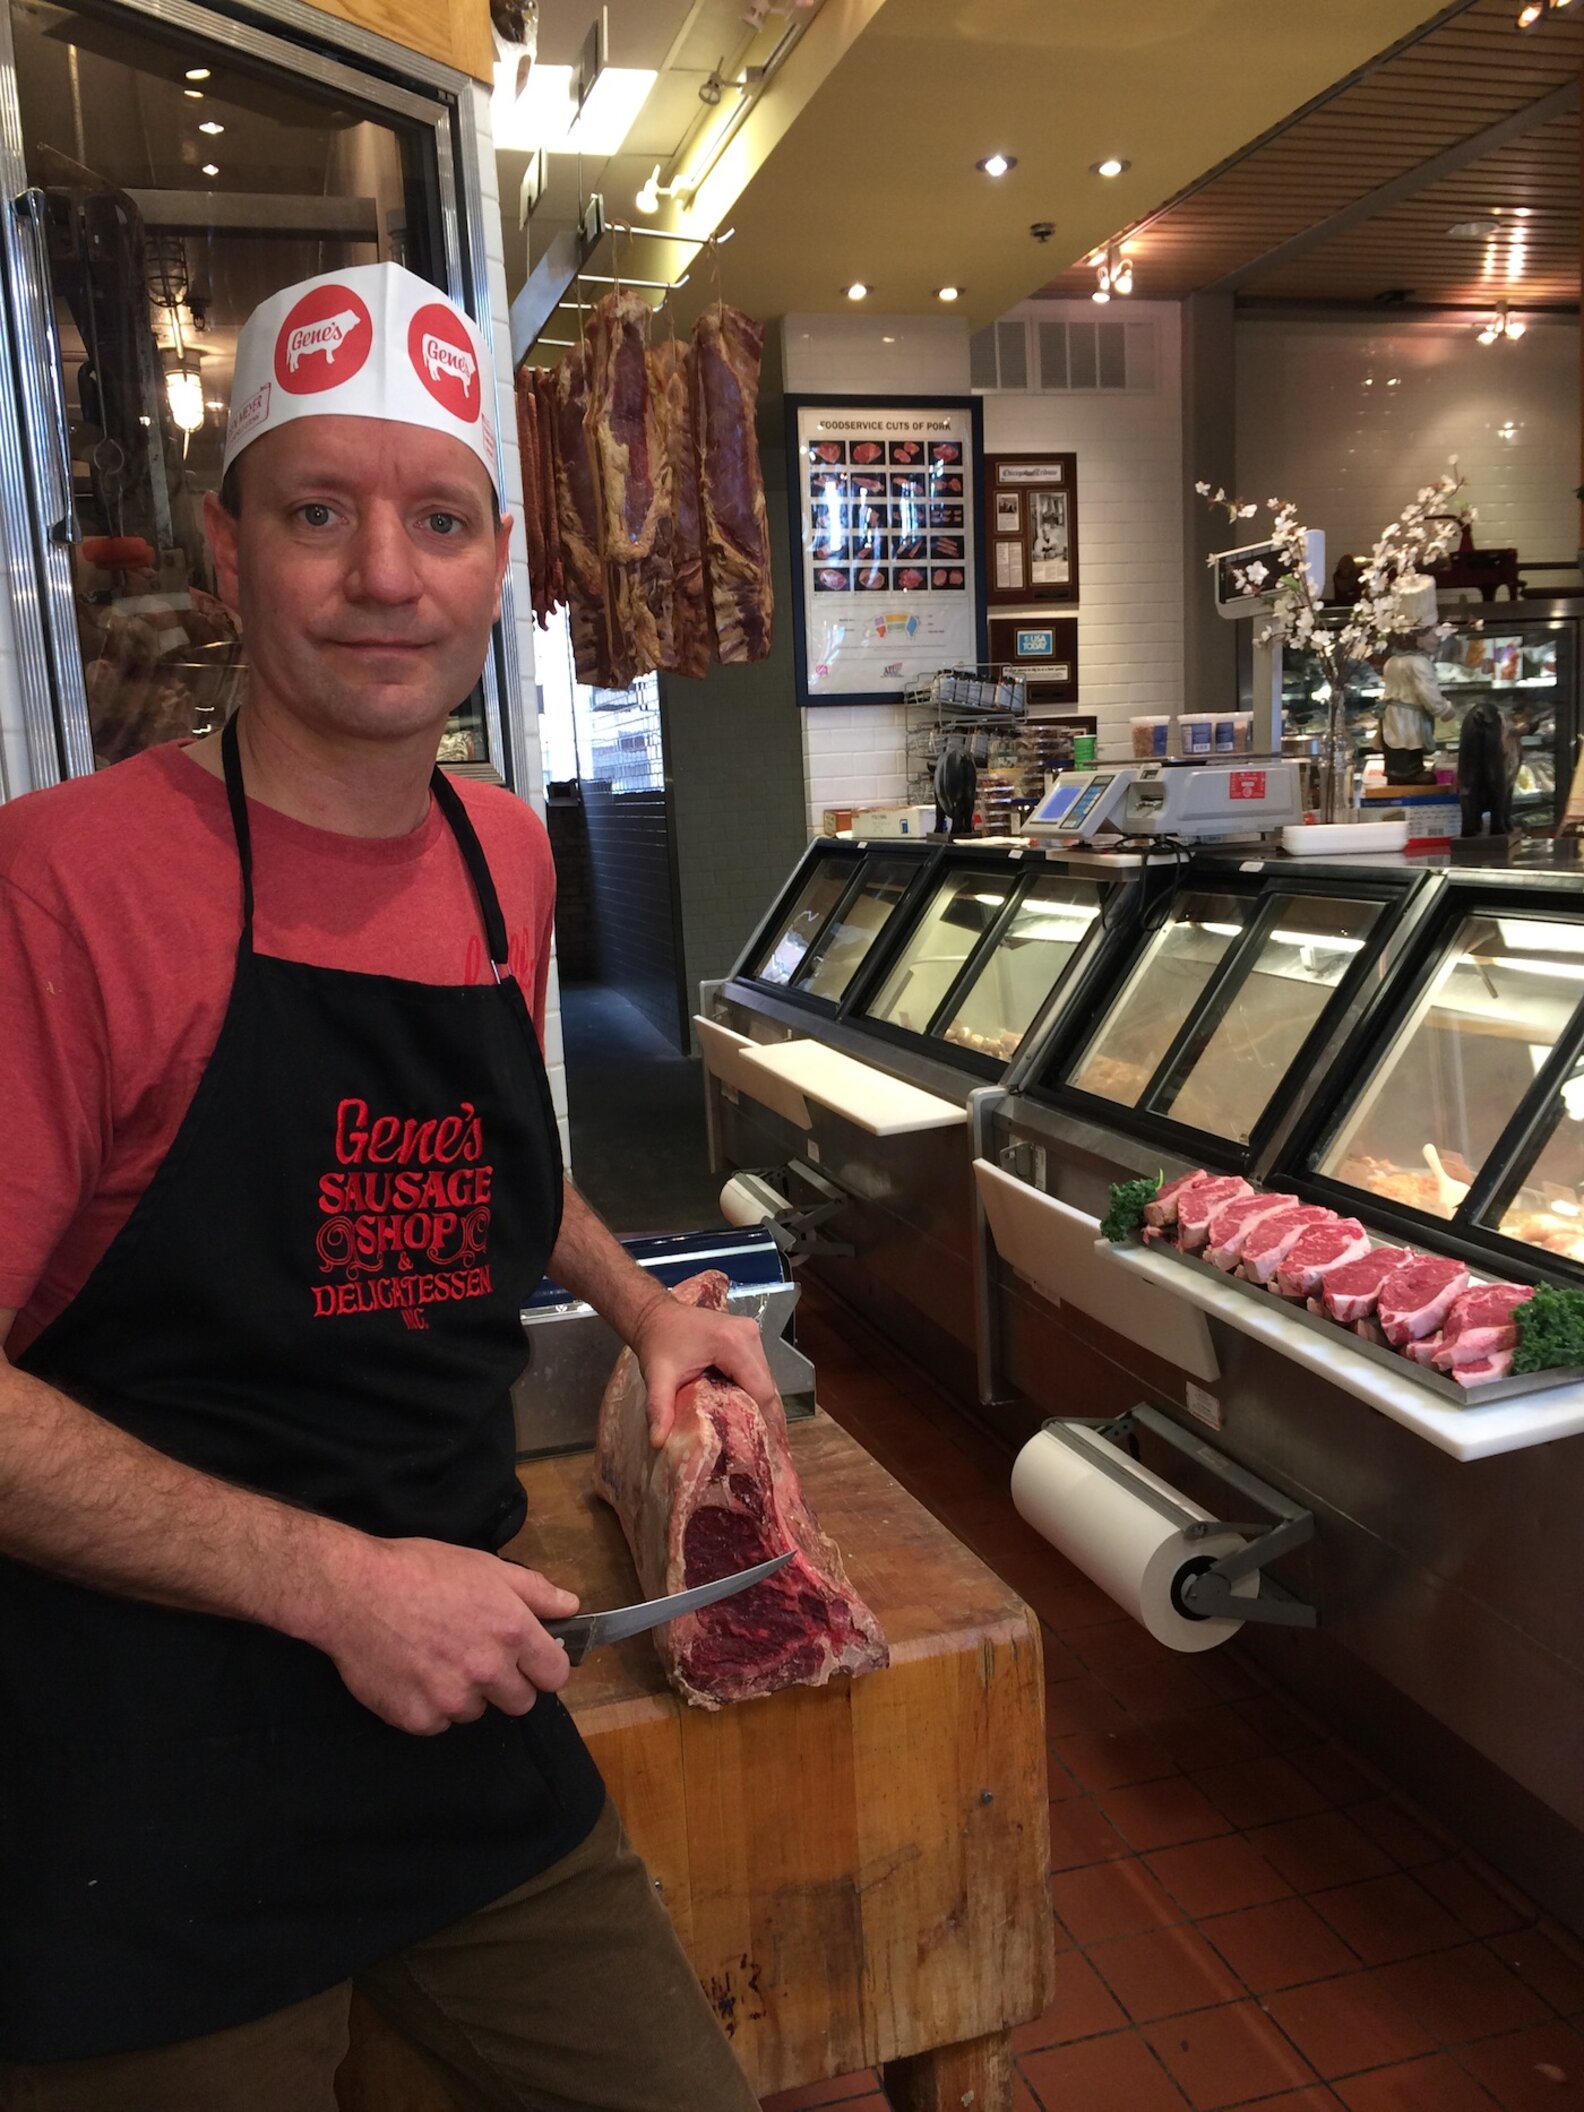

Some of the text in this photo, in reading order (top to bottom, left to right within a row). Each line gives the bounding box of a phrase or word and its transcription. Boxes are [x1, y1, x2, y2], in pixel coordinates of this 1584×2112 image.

[292, 321, 343, 352] Gene's
[427, 340, 472, 378] Gene's
[820, 420, 951, 431] FOODSERVICE CUTS OF PORK
[335, 1098, 483, 1165] Gene's
[318, 1165, 494, 1214] SAUSAGE
[355, 1212, 459, 1254] SHOP
[398, 1251, 413, 1272] &
[311, 1265, 494, 1318] DELICATESSEN
